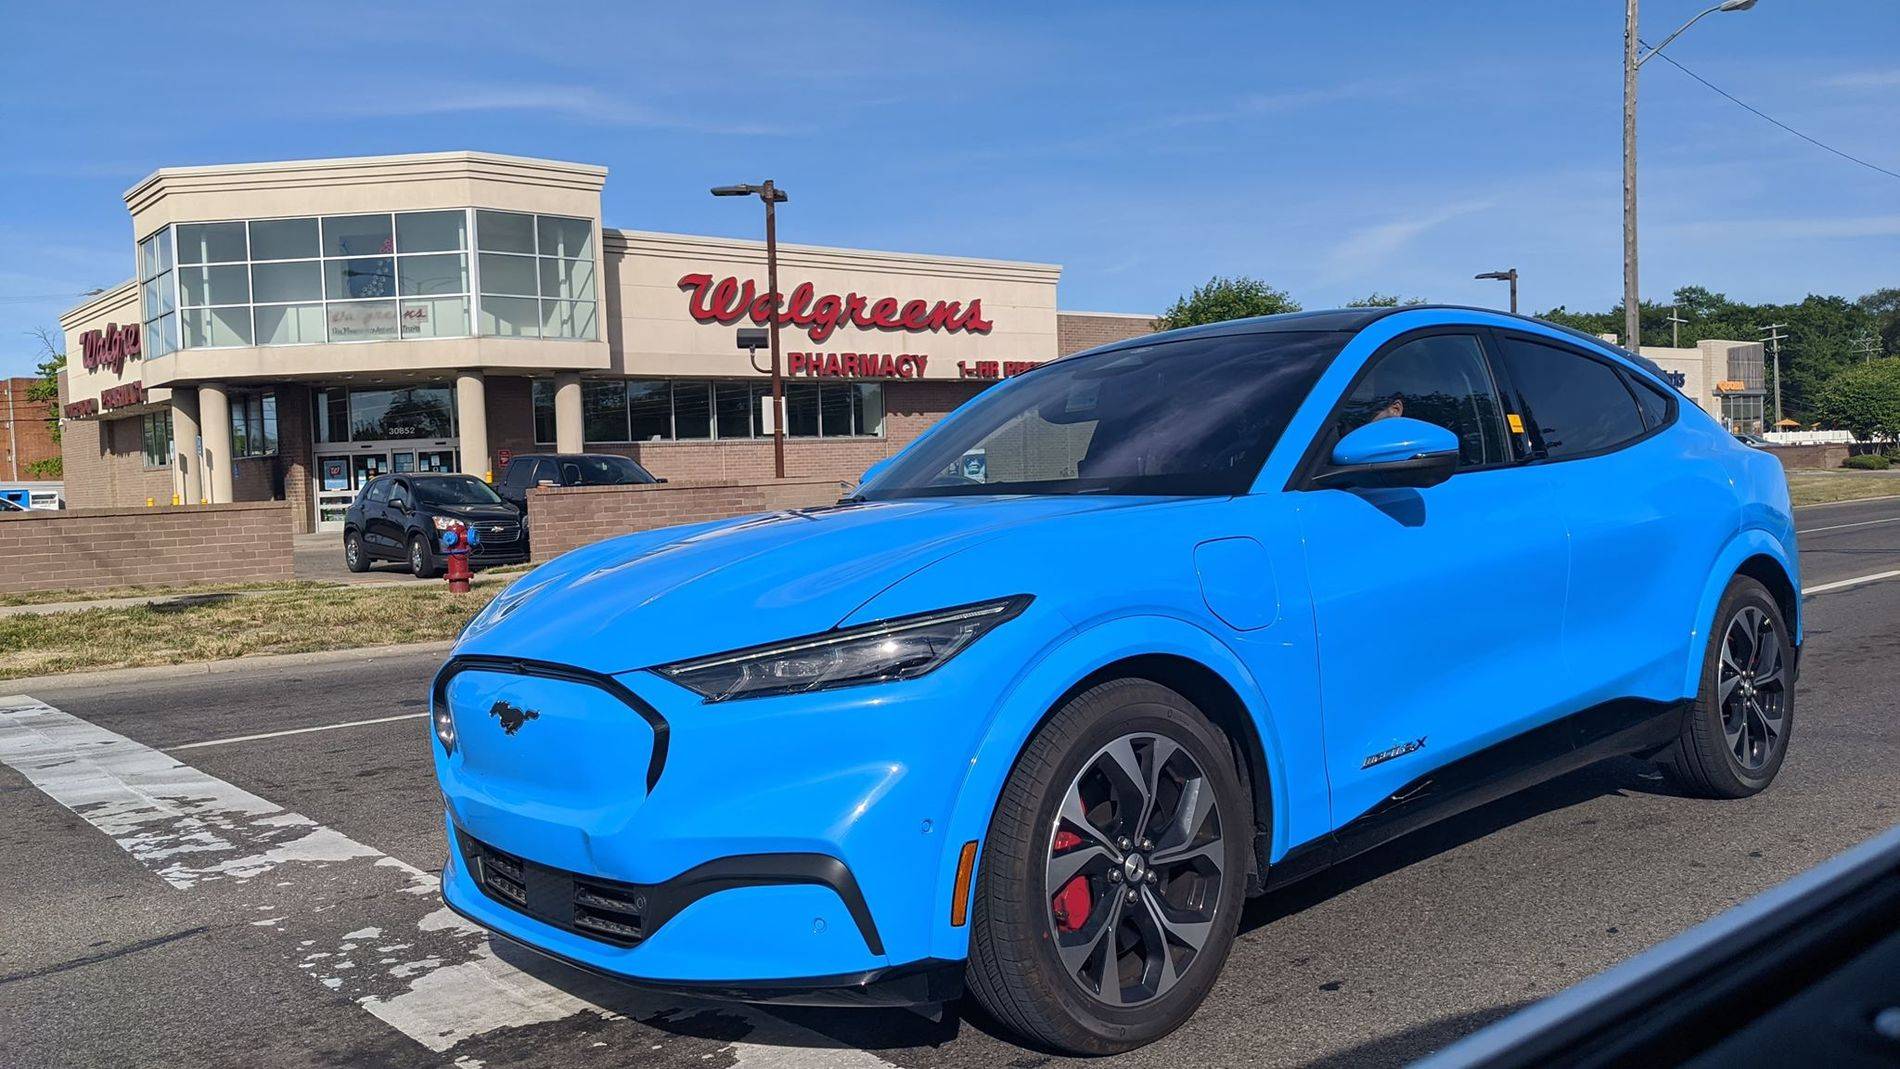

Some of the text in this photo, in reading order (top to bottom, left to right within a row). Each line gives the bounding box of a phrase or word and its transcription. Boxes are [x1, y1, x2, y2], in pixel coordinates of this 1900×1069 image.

[677, 273, 993, 342] Walgreens
[788, 352, 928, 378] PHARMACY
[388, 426, 415, 435] 30852
